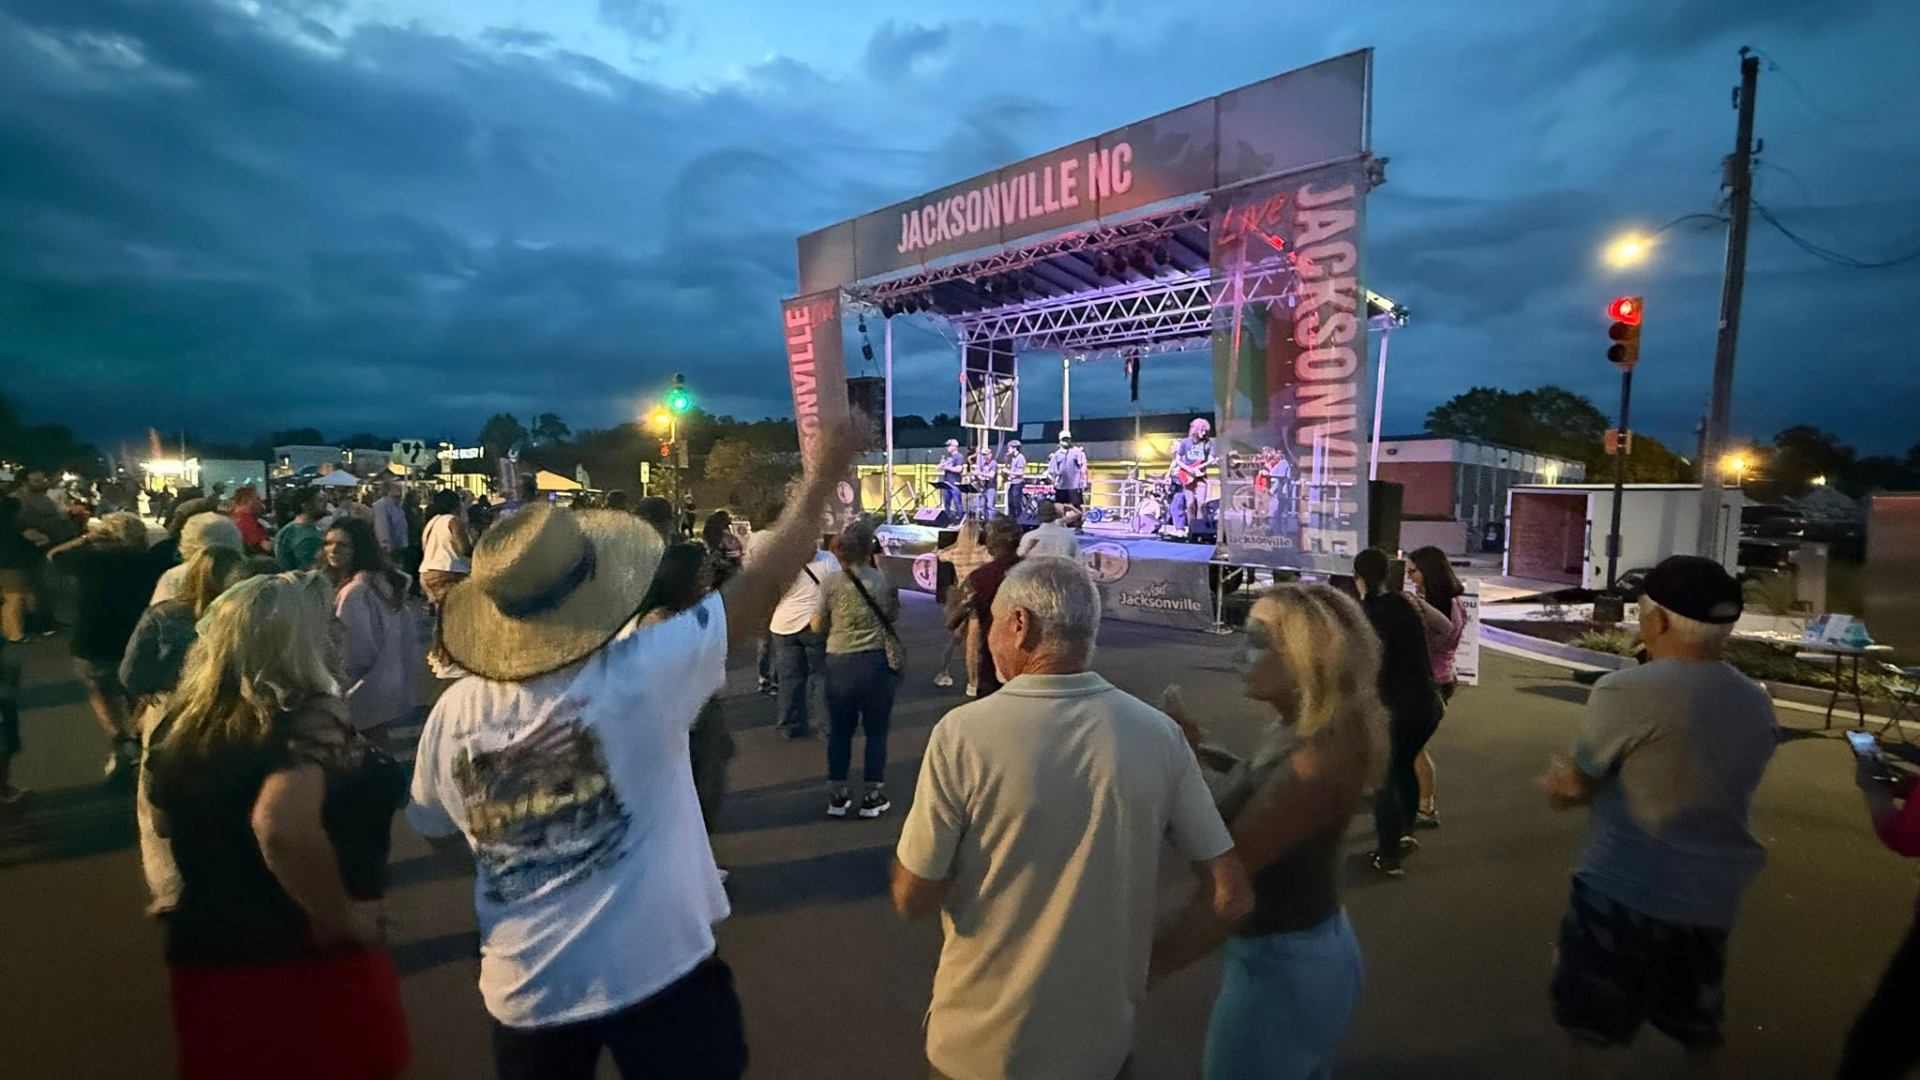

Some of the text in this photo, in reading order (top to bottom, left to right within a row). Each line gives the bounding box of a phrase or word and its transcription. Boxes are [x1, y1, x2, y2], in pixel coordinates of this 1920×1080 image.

[898, 143, 1132, 253] JACKSONVILLE NC
[1294, 183, 1357, 556] JACKSONVILLE
[1120, 592, 1201, 611] Jacksonville
